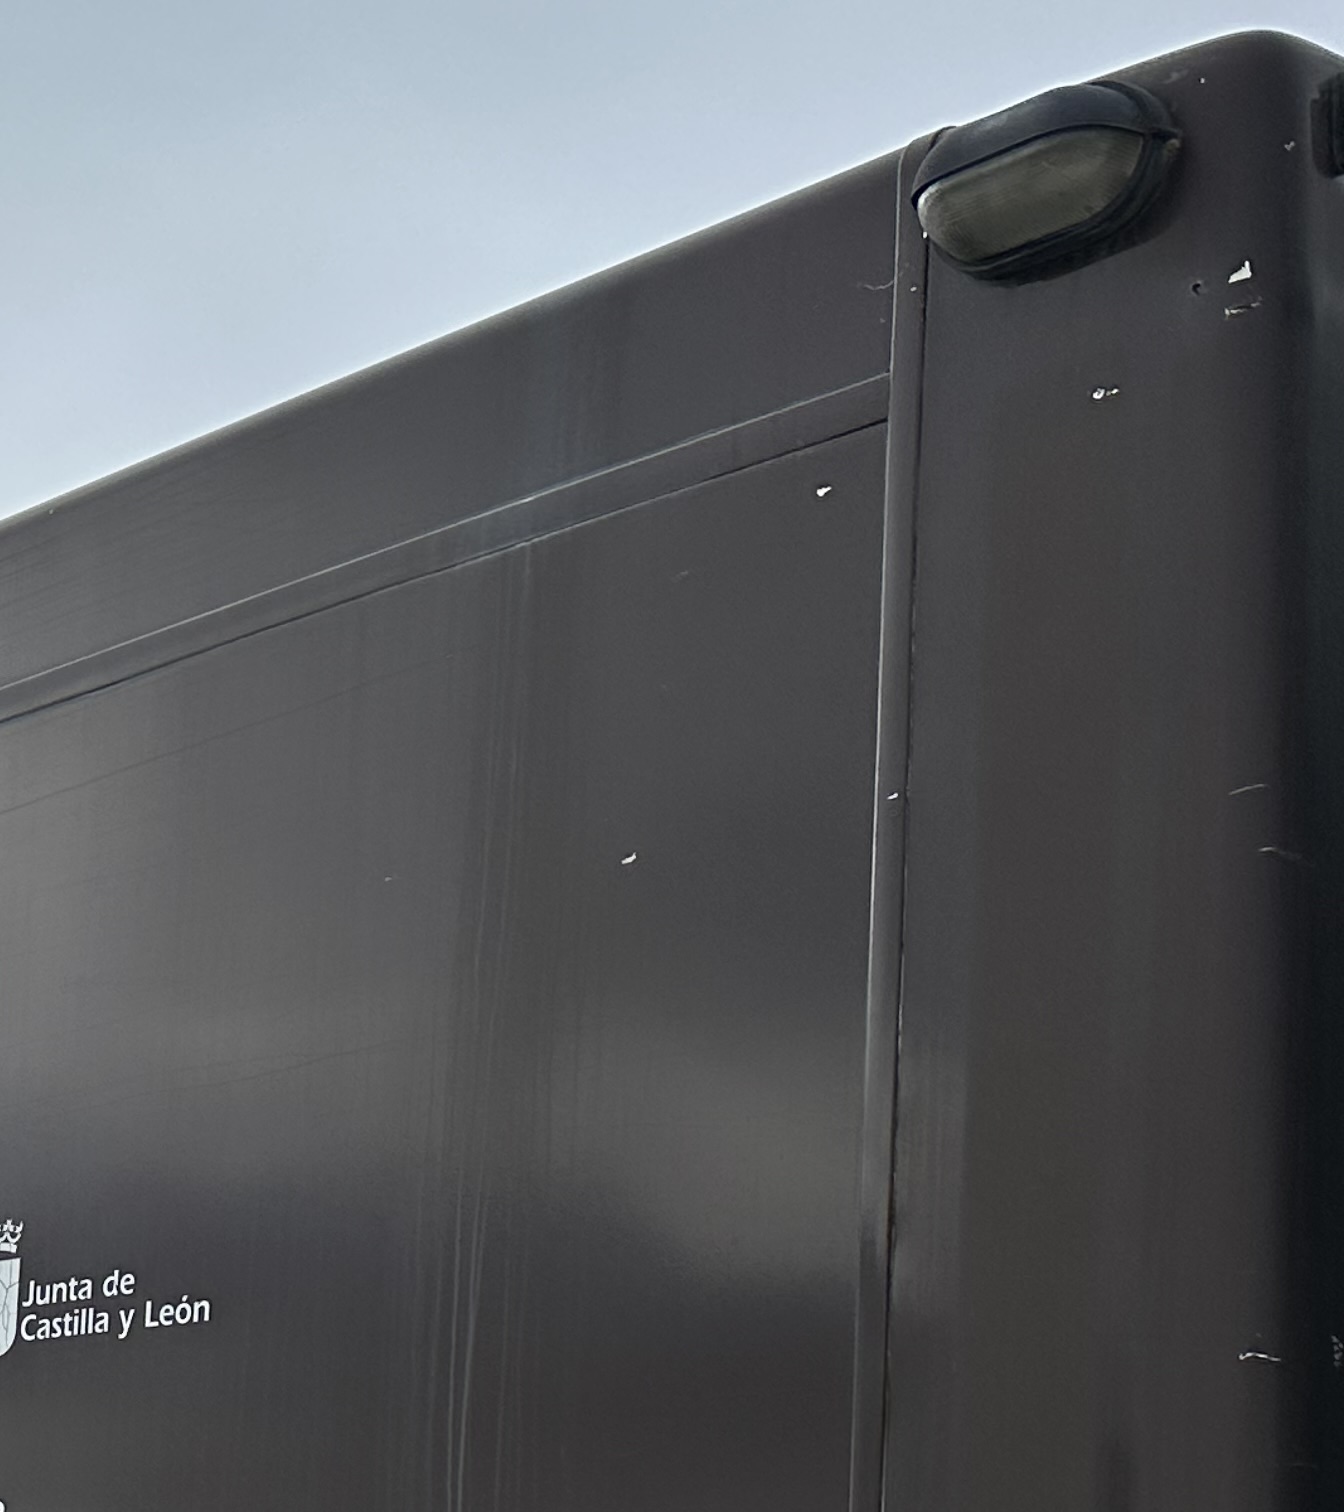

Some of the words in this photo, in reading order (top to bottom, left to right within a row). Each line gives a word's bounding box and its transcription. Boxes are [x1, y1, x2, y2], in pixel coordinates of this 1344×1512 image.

[22, 1276, 93, 1308] Junta
[102, 1269, 135, 1297] de
[20, 1307, 109, 1341] Castilla
[117, 1308, 135, 1339] y
[144, 1294, 210, 1328] León
